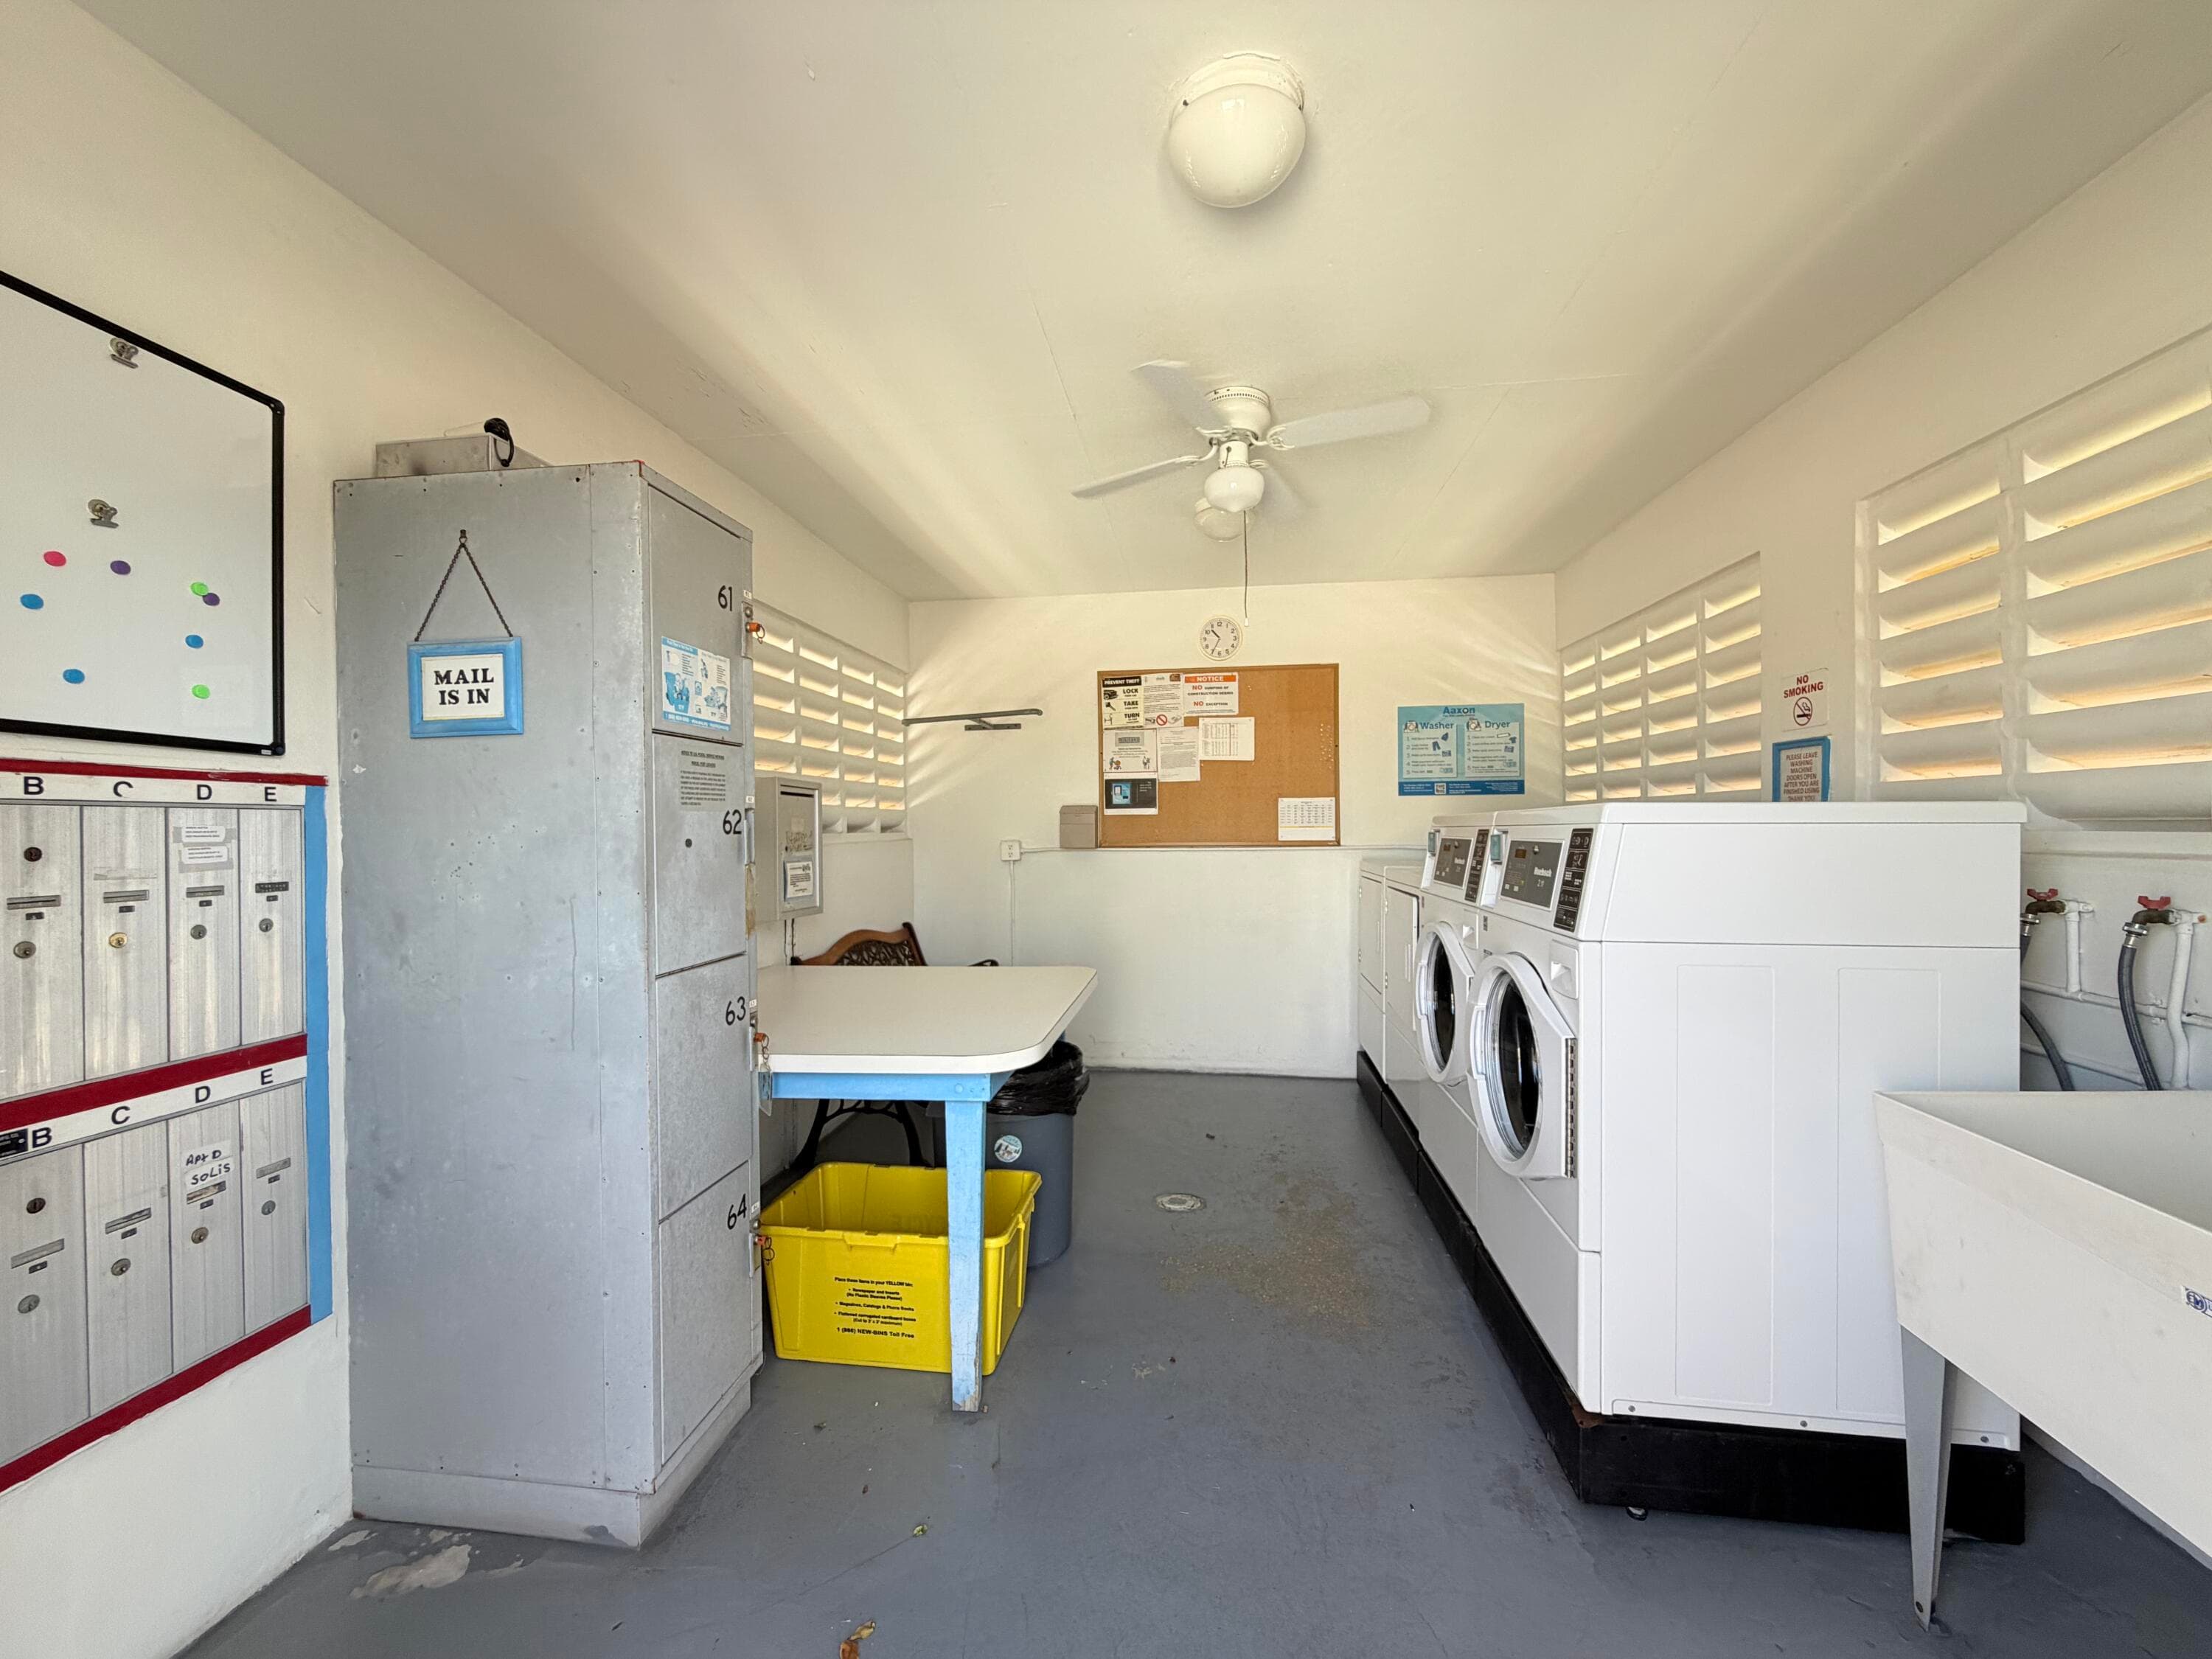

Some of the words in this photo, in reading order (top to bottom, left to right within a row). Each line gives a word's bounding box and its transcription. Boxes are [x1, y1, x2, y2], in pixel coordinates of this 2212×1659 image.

[717, 585, 733, 611] 61
[434, 668, 494, 685] MAIL
[1796, 675, 1809, 685] NO
[439, 689, 459, 705] IS
[467, 688, 490, 704] IN
[1783, 681, 1824, 699] SMOKING
[1443, 706, 1475, 714] Aaxon
[1485, 721, 1511, 729] Dryer
[23, 776, 44, 795] B
[113, 781, 133, 798] C
[197, 784, 212, 800] D
[264, 786, 277, 802] E
[723, 809, 742, 835] 62
[726, 996, 746, 1026] 63
[261, 1068, 273, 1085] E
[195, 1086, 211, 1103] D
[111, 1106, 131, 1125] C
[32, 1127, 52, 1148] B
[212, 1150, 221, 1159] D
[727, 1193, 747, 1230] 64
